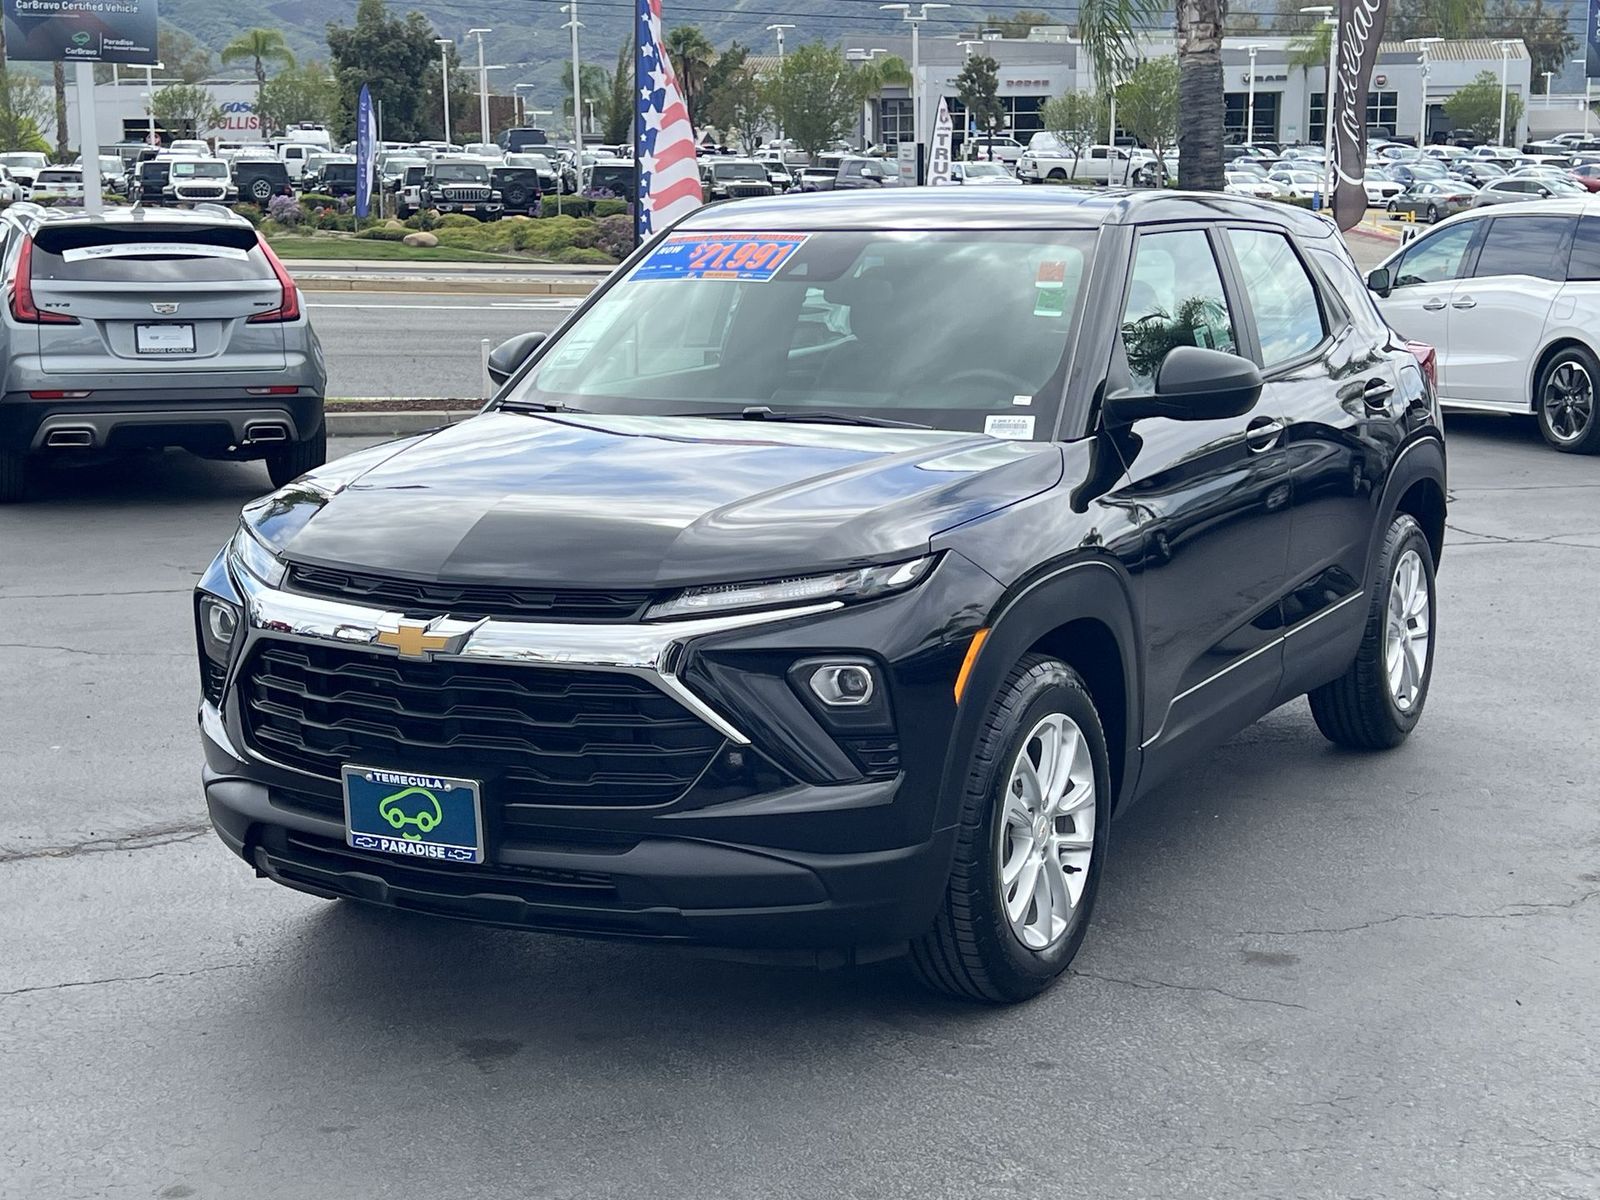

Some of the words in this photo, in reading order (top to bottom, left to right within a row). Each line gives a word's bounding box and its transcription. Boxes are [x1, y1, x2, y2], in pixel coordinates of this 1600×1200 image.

[15, 0, 60, 10] CarBravo
[62, 1, 103, 11] Certified
[105, 3, 138, 13] Vehicle
[65, 47, 98, 56] CarBravo
[1006, 79, 1050, 88] DODGE
[658, 245, 684, 255] NOW
[689, 242, 795, 271] $21,991
[373, 772, 443, 789] TEMECULA
[380, 839, 446, 859] PARADISE
